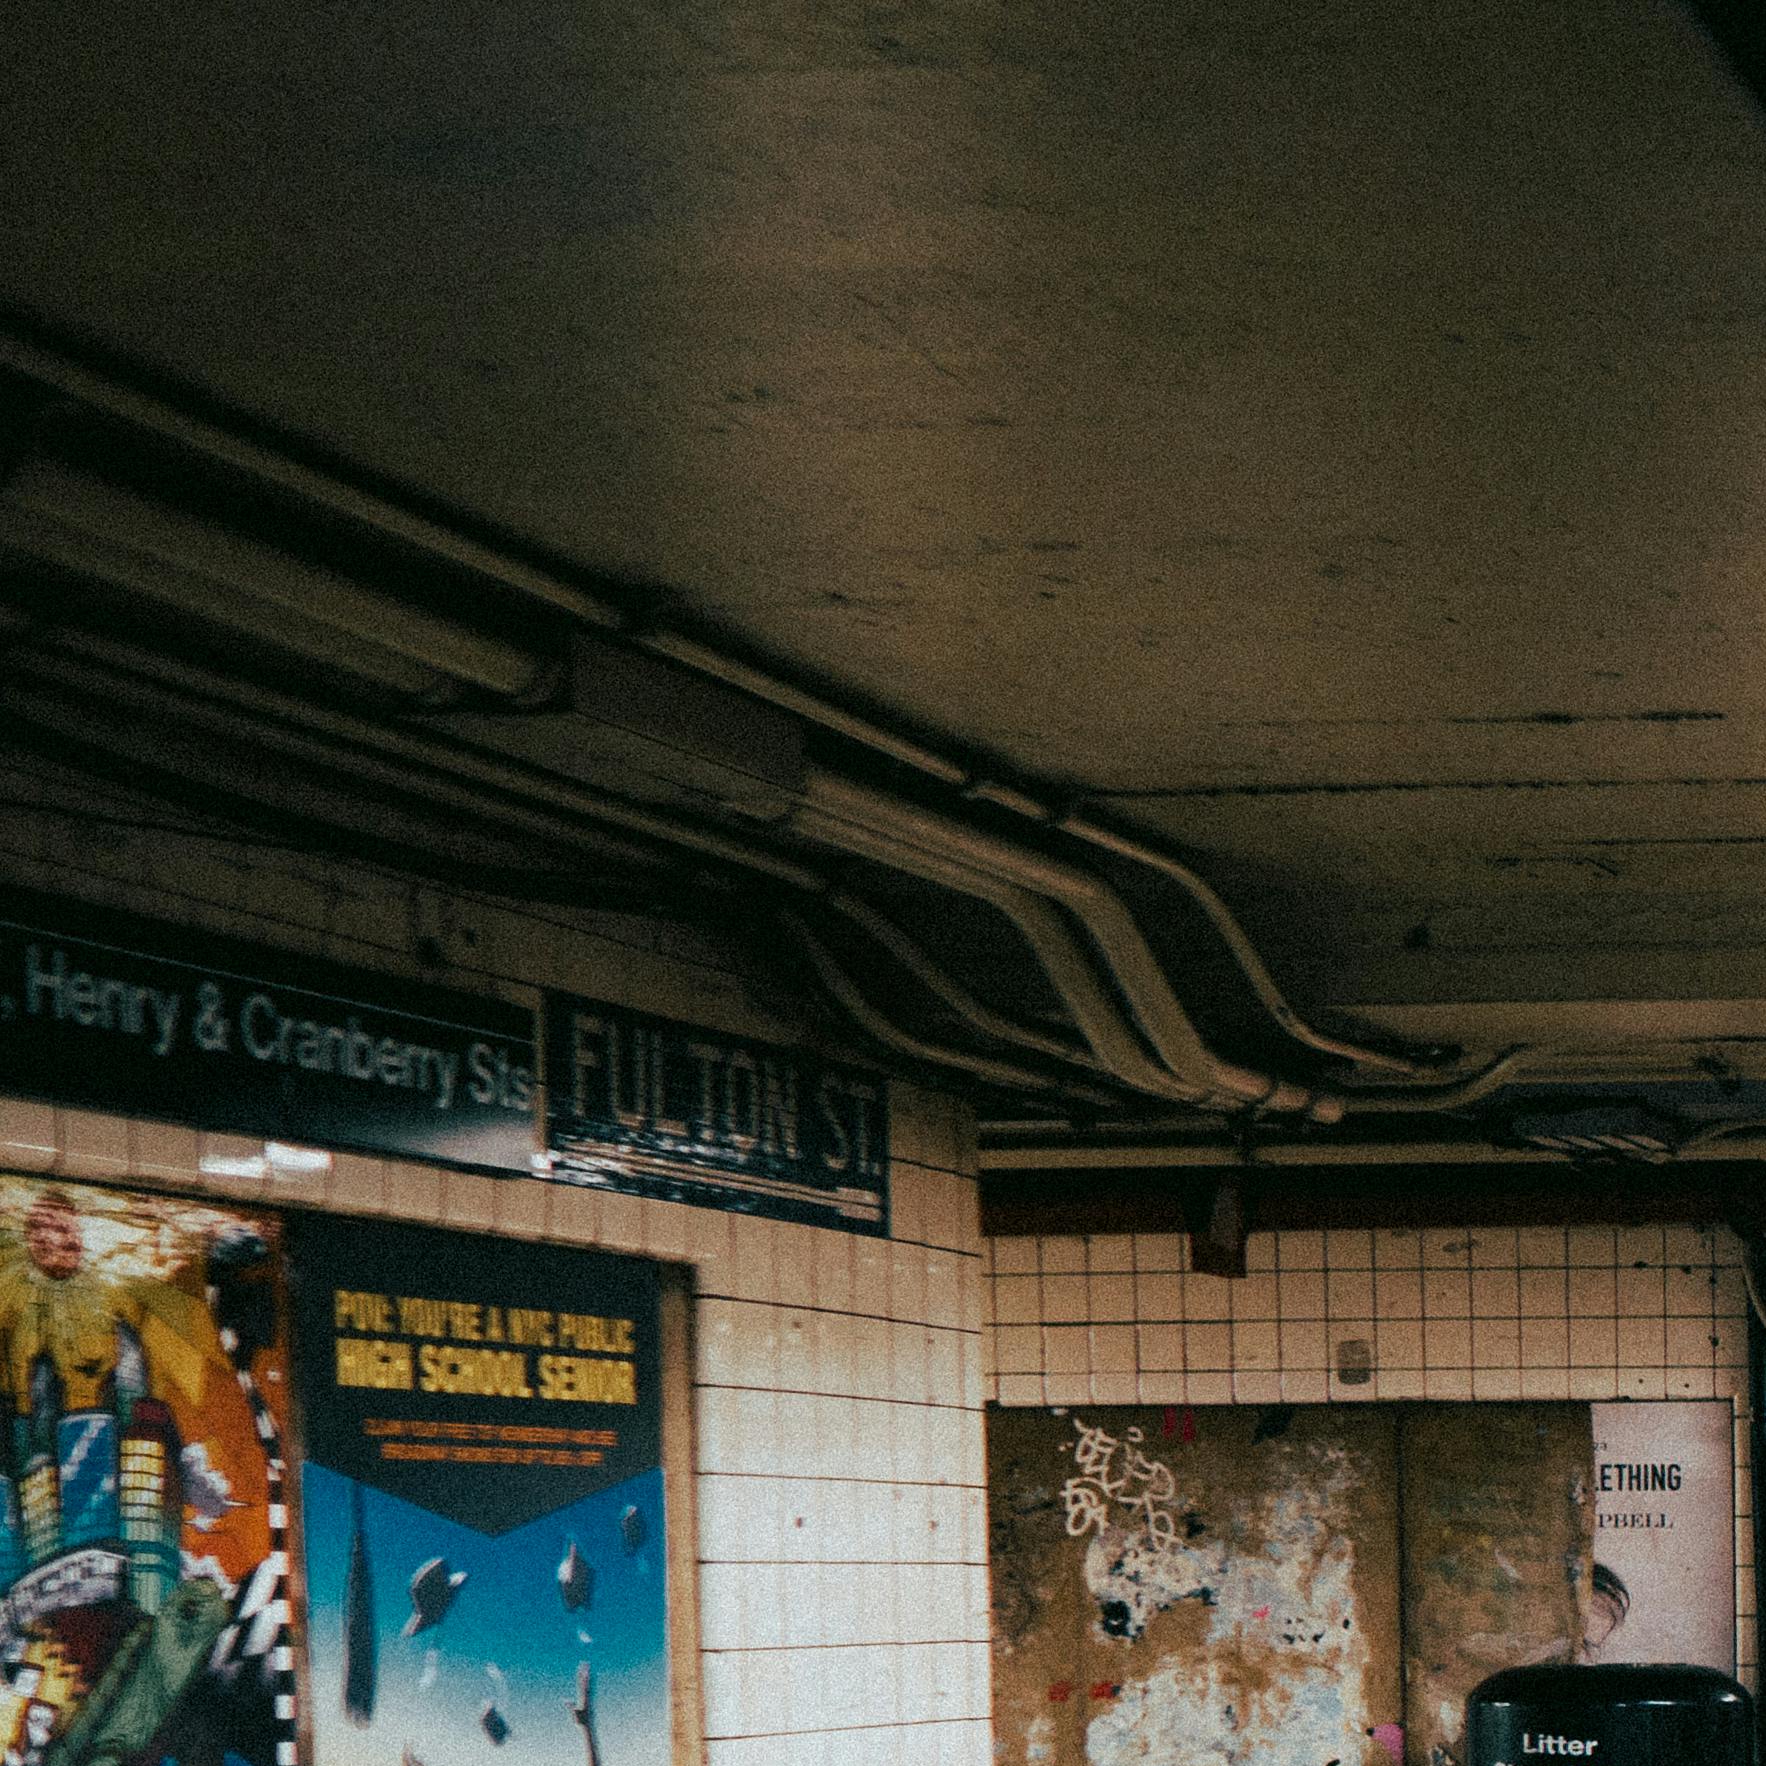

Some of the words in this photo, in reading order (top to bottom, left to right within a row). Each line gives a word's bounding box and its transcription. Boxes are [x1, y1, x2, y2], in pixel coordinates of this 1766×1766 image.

[25, 945, 179, 1056] Henry
[192, 982, 229, 1052] &
[240, 995, 457, 1108] Cranberry
[572, 1013, 799, 1159] FULTON
[336, 1338, 413, 1390] HIGH
[420, 1344, 534, 1399] SCHOOL
[539, 1354, 638, 1405] SENIOR
[1595, 1463, 1682, 1492] ETHING
[1523, 1733, 1598, 1756] Litter
